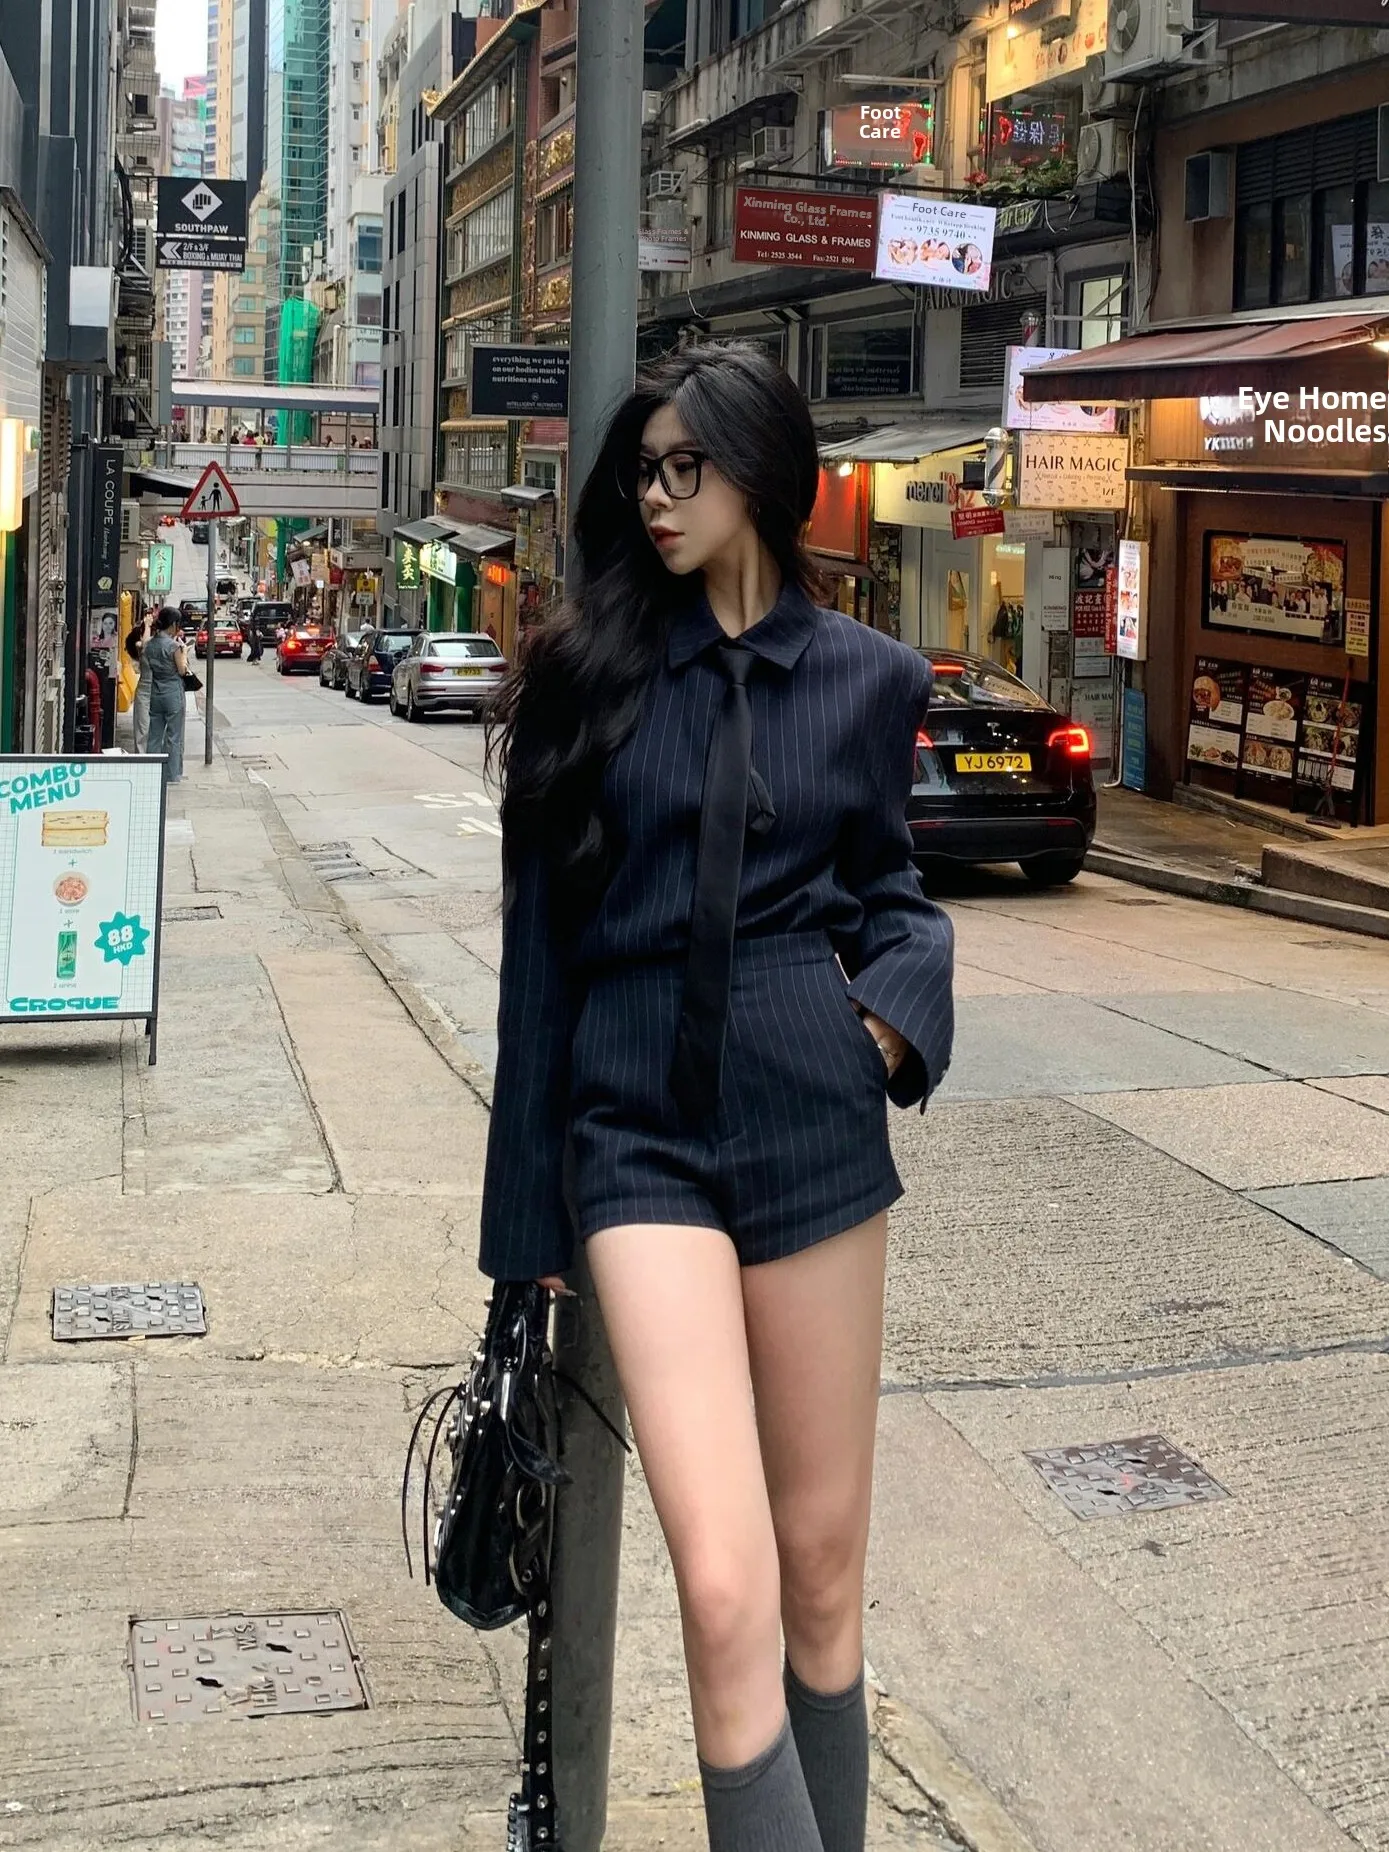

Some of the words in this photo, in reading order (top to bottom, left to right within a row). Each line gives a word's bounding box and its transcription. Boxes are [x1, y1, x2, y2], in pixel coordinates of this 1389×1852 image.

[912, 202, 937, 215] Foot
[940, 206, 967, 219] Care
[175, 223, 228, 233] SOUTHPAW
[916, 225, 940, 236] 9735
[942, 228, 966, 239] 9740
[740, 230, 781, 241] KINMING
[785, 233, 818, 244] GLASS
[821, 236, 828, 245] &
[831, 237, 872, 248] FRAMES
[183, 252, 205, 260] BOXING
[211, 252, 228, 261] MUAY
[228, 253, 243, 262] THAI
[771, 251, 786, 259] 2525
[492, 355, 531, 365] everything
[543, 357, 556, 366] put
[515, 366, 538, 374] bodies
[539, 367, 557, 375] must
[557, 367, 566, 375] be
[527, 376, 541, 384] and
[541, 376, 558, 385] safe.
[105, 459, 116, 476] LA
[1025, 455, 1064, 470] HAIR
[1069, 457, 1122, 472] MAGIC
[104, 480, 115, 525] COUPE
[964, 756, 983, 769] YJ
[986, 755, 1024, 769] 6972
[0, 762, 87, 799] COMBO
[10, 779, 80, 814] MENU
[108, 924, 134, 947] 88
[113, 941, 134, 954] HKD
[10, 996, 120, 1012] CROQUE
